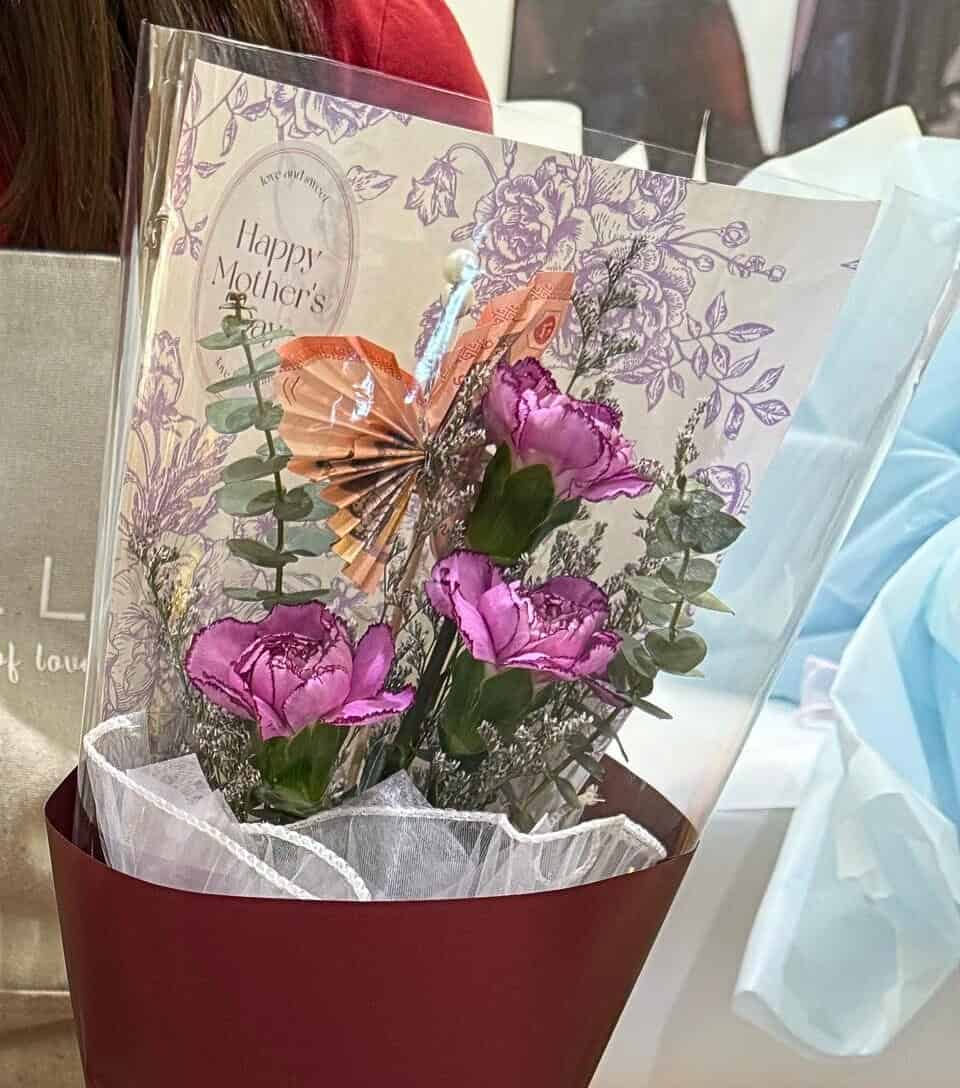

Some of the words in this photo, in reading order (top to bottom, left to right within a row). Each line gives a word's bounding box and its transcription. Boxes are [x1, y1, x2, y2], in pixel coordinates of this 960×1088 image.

[259, 171, 281, 187] love
[283, 167, 304, 182] and
[304, 175, 330, 202] sweet
[236, 219, 323, 274] Happy
[211, 254, 327, 314] Mother's
